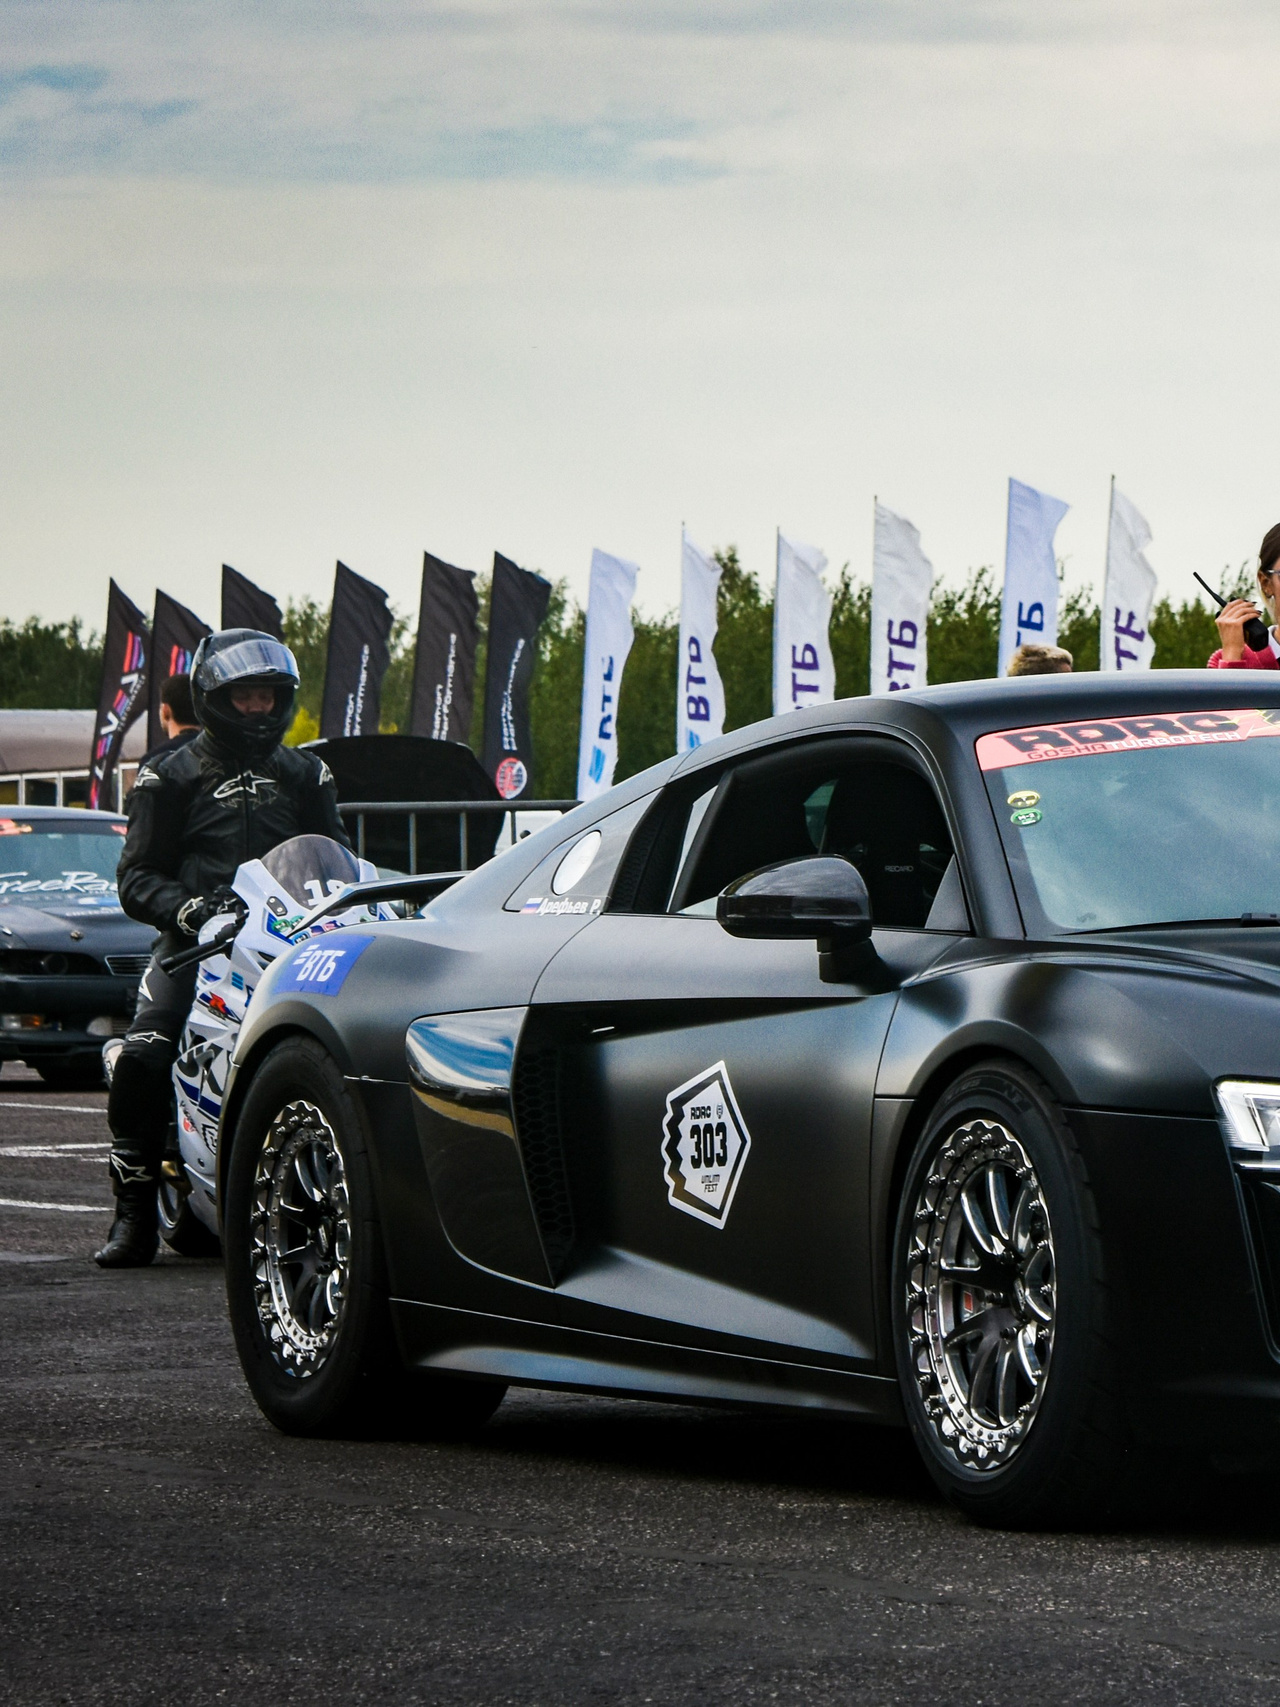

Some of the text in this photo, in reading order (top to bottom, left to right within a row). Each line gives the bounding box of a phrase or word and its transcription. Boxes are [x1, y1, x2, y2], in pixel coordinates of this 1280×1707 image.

[791, 643, 820, 710] ТБ
[997, 712, 1241, 754] RDRC
[1027, 730, 1242, 761] GOSHATURBOTECH
[884, 865, 914, 873] RECARO
[535, 897, 589, 916] Арефьев
[296, 949, 347, 982] ВТБ
[690, 1106, 711, 1120] RDRC
[690, 1122, 727, 1169] 303
[704, 1183, 719, 1193] FEST
